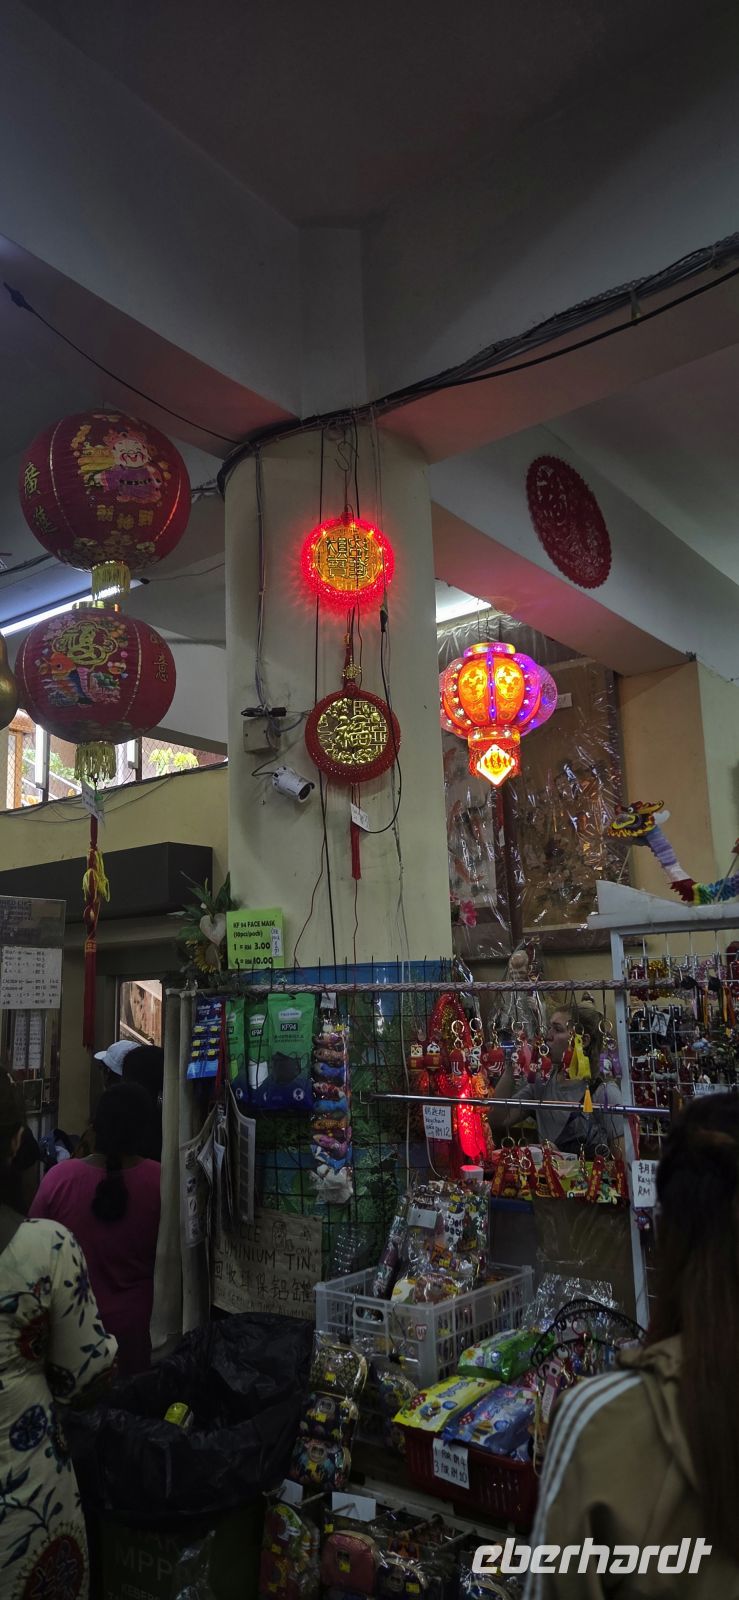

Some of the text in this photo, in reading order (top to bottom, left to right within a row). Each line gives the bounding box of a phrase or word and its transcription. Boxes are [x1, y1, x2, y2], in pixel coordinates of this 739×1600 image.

[254, 942, 271, 950] 3.00
[252, 957, 273, 965] 10.00
[281, 1023, 297, 1031] KF94
[215, 1239, 311, 1271] LUMINIUM TIN
